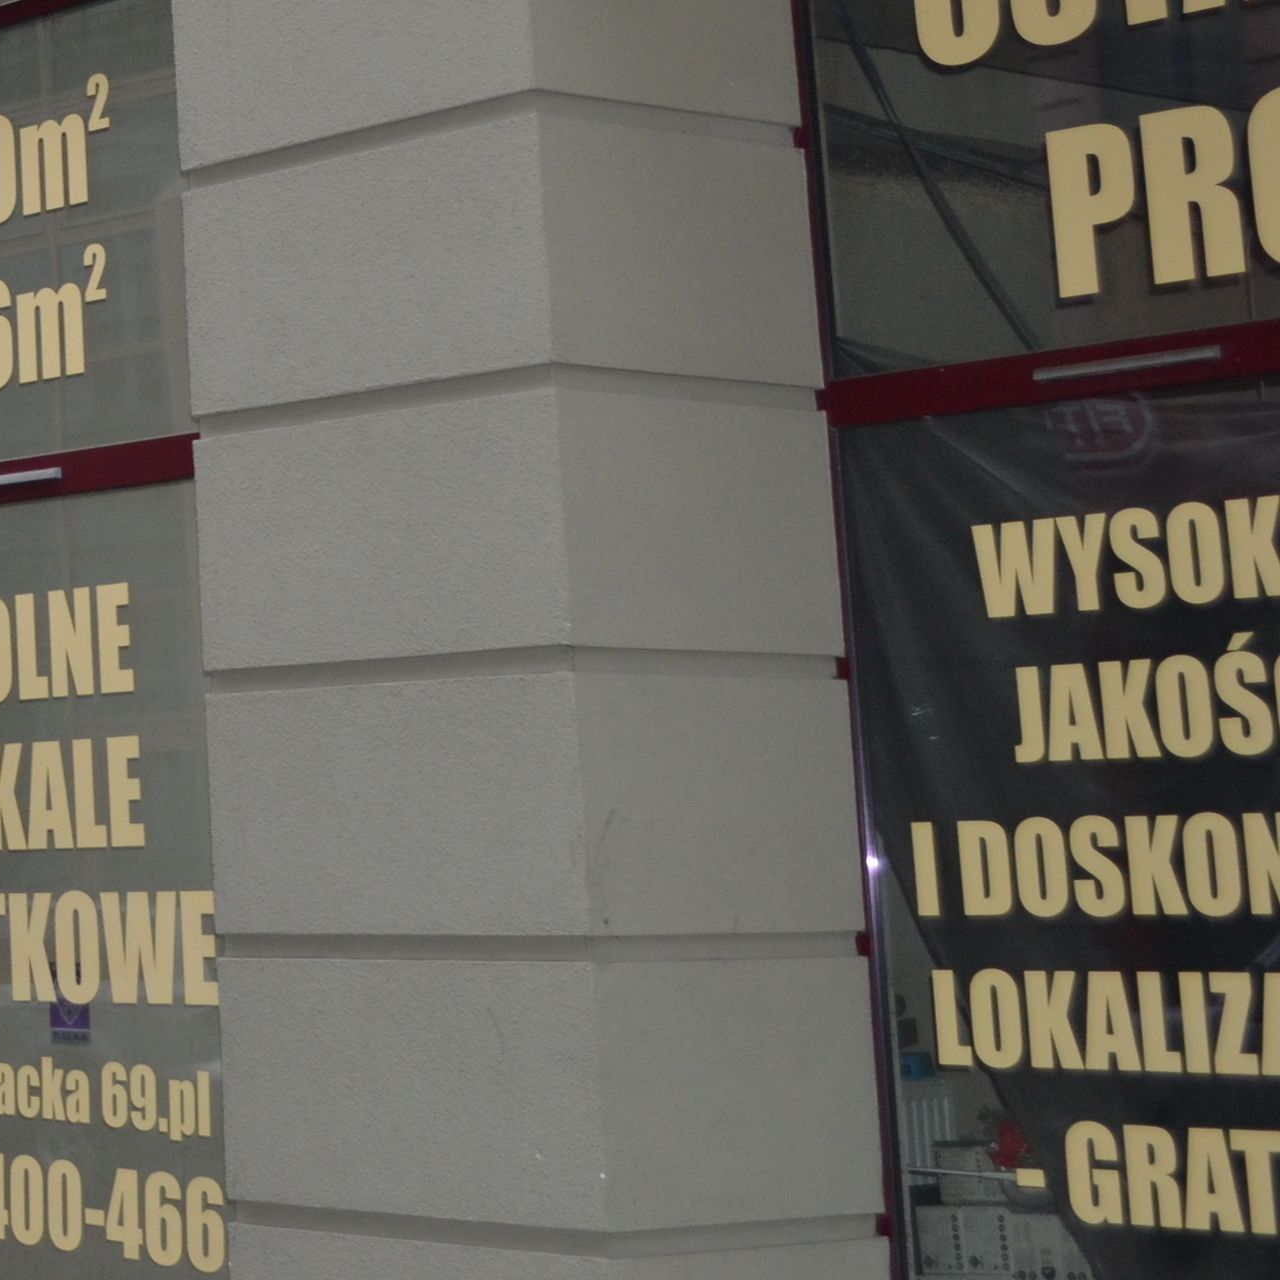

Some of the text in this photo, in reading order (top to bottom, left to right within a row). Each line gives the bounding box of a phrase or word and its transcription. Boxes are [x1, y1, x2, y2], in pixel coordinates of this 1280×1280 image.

[1015, 631, 1280, 763] JAKOŚ
[911, 821, 940, 917] I
[100, 1061, 213, 1143] 69.pl
